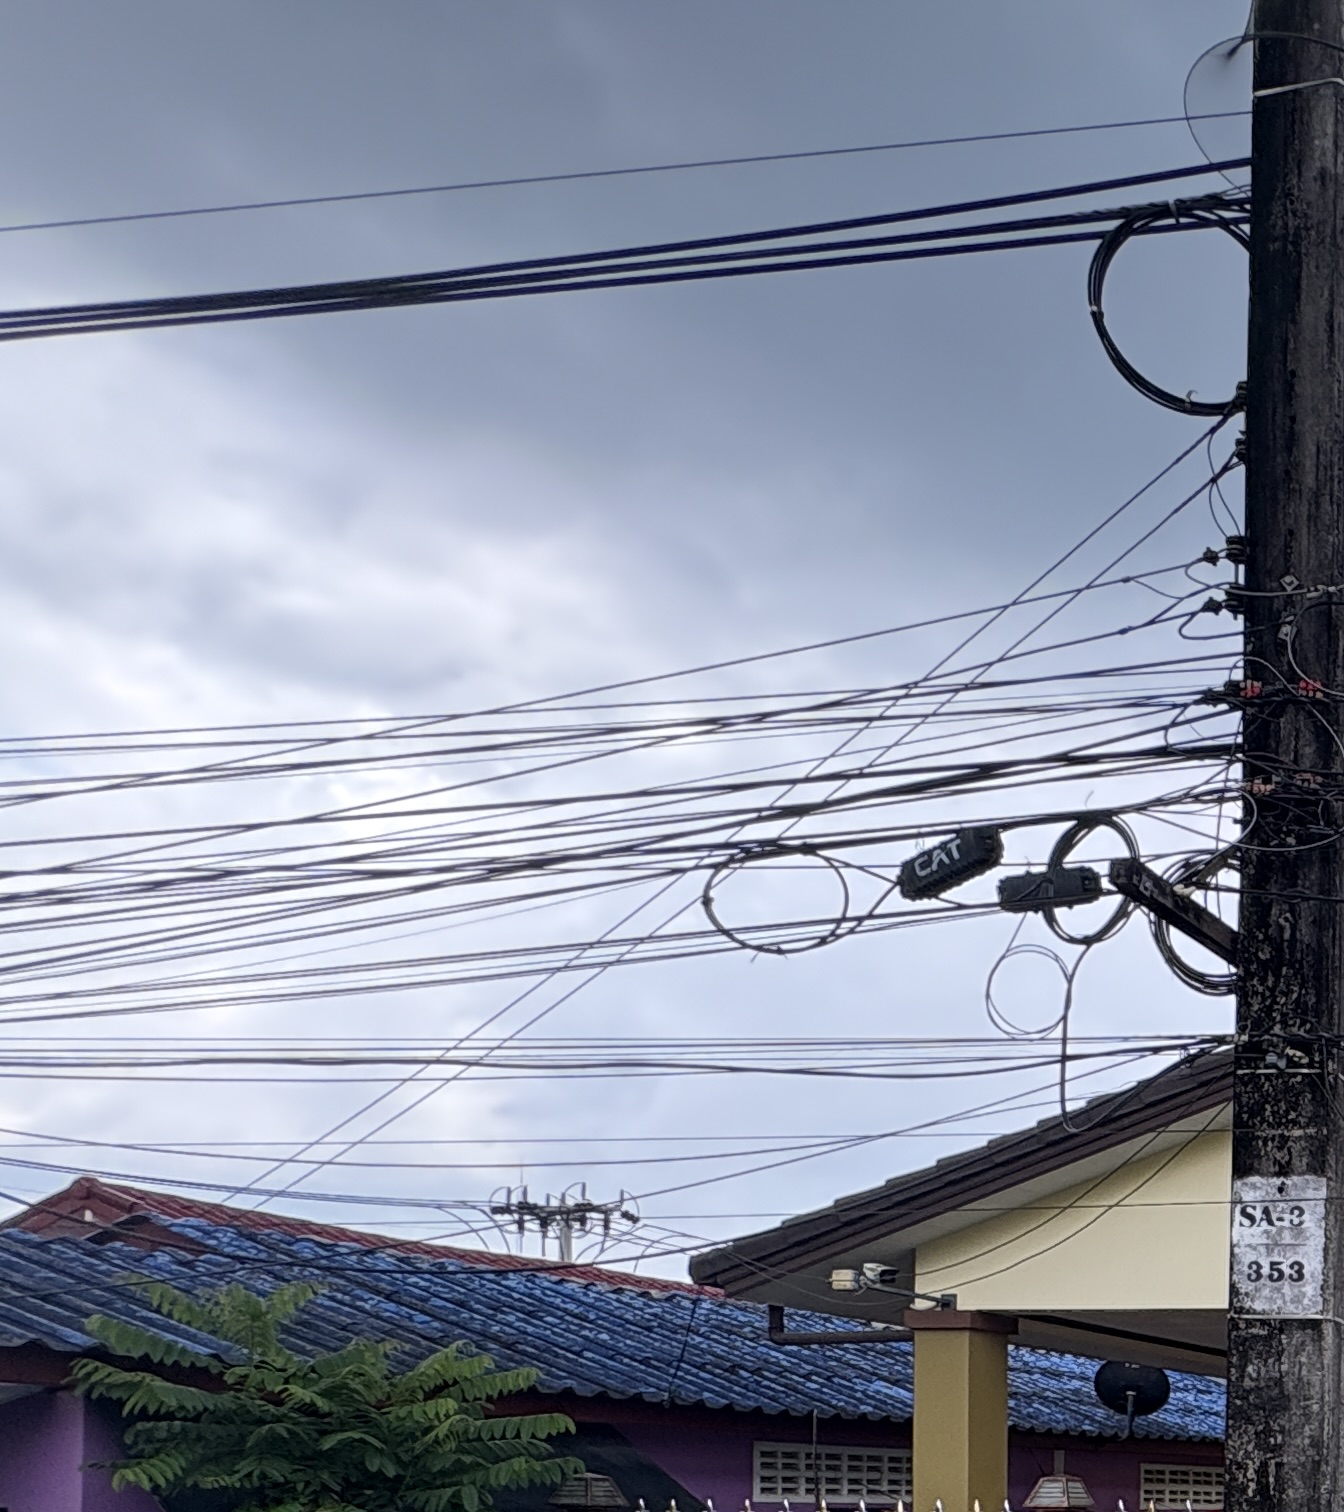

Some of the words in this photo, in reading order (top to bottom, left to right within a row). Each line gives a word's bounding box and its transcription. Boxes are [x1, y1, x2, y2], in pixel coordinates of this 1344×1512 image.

[913, 838, 962, 877] CAT
[1239, 1205, 1306, 1228] SA-3
[1247, 1260, 1305, 1283] 353
